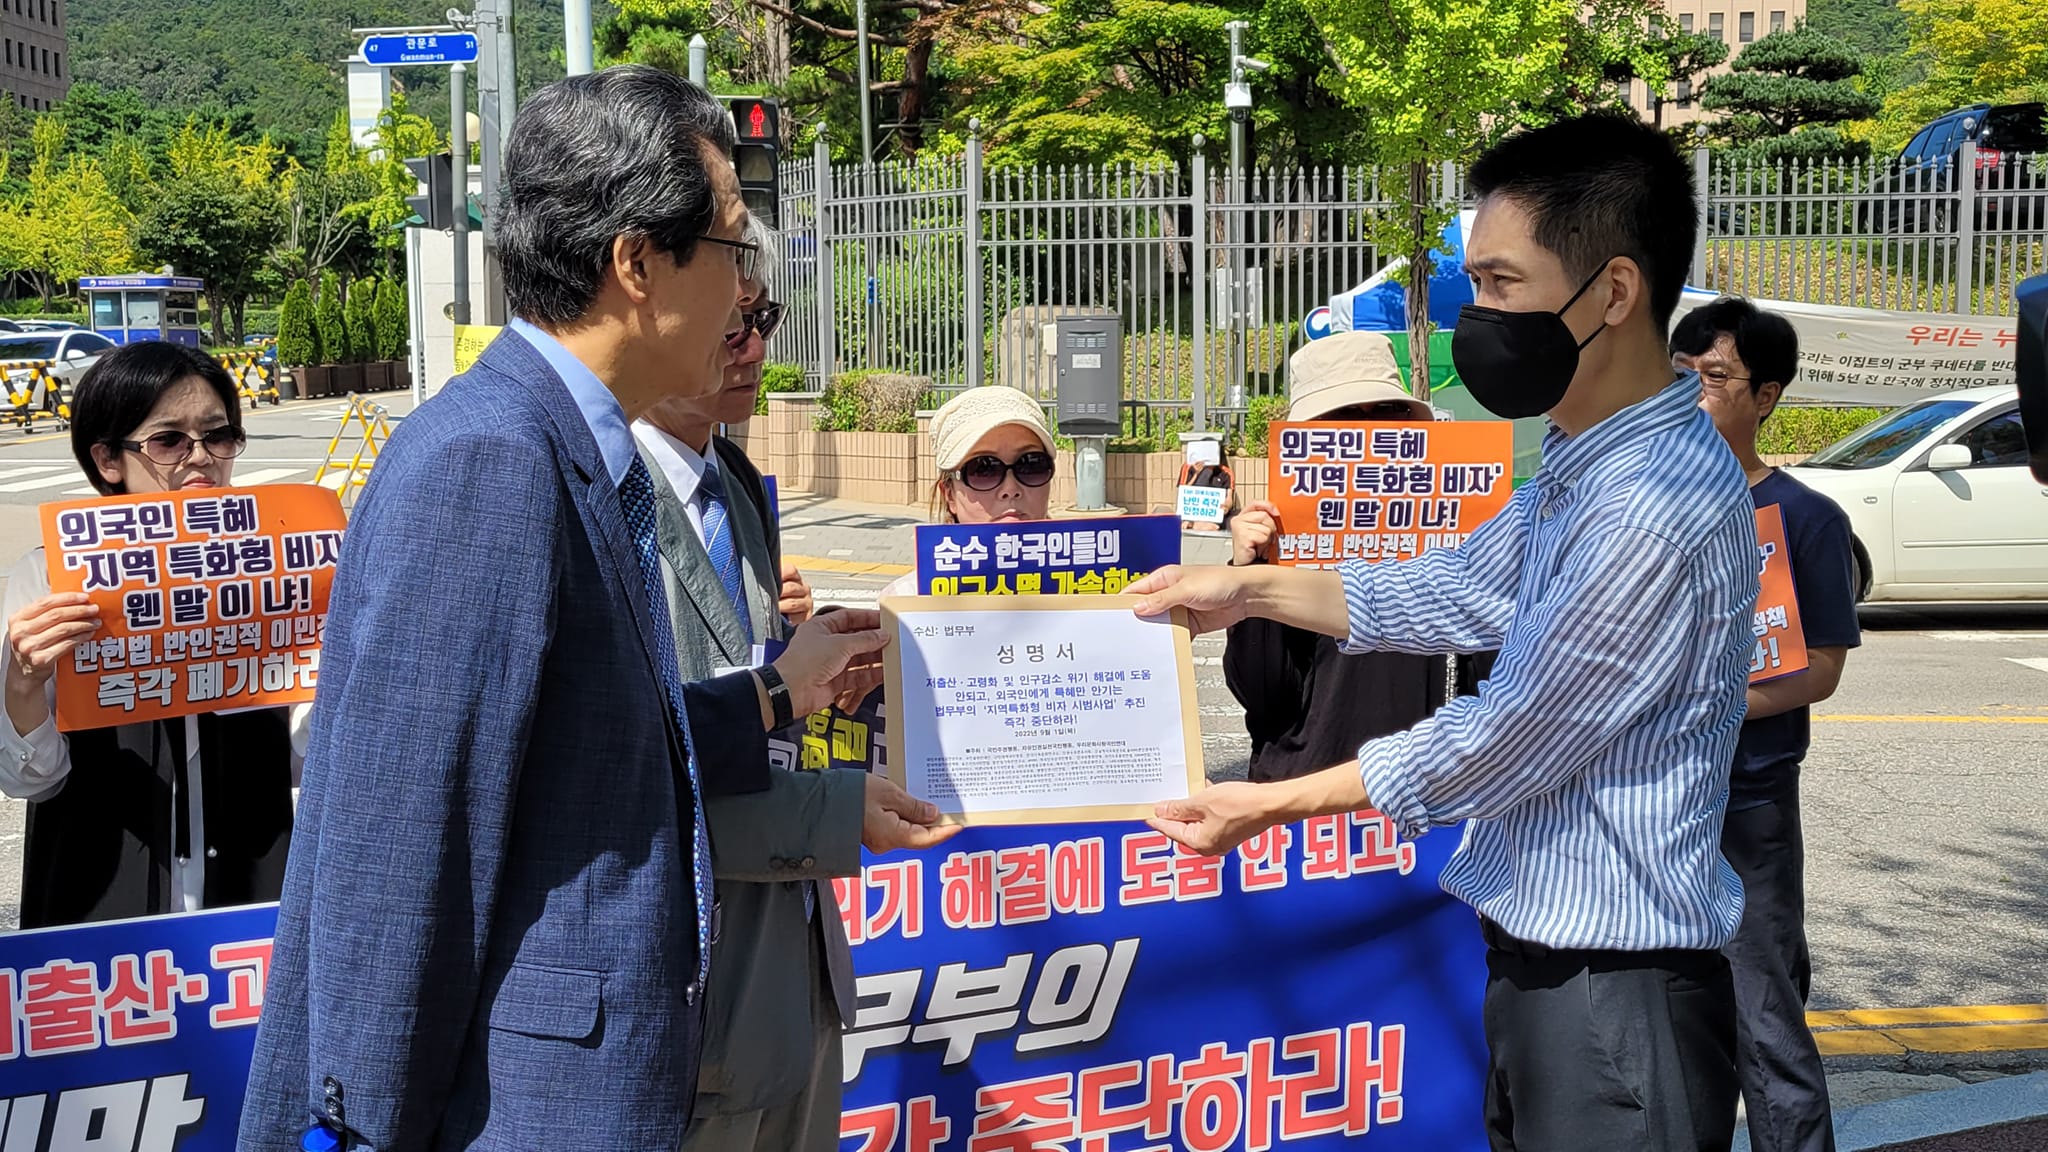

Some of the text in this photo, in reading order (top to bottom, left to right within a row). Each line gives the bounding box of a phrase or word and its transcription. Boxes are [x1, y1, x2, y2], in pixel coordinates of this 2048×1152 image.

[369, 44, 378, 52] 47
[406, 37, 437, 49] 관문로
[1906, 325, 1984, 347] 우리는
[1839, 355, 1894, 370] 이집트의
[1898, 358, 1926, 371] 군부
[1931, 359, 1986, 372] 쿠데타를
[1808, 368, 1833, 383] 위해
[1837, 372, 1860, 385] 5년
[1865, 374, 1879, 385] 전
[1884, 375, 1926, 388] 한국에
[1282, 430, 1425, 459] 외국인 특혜
[1283, 464, 1502, 494] '지역 특화형 비자'
[58, 496, 257, 548] 외국인 특혜
[1319, 500, 1459, 528] 웬 말 이 냐!
[67, 550, 157, 589] '지역
[169, 537, 273, 578] 특화형
[934, 530, 1120, 571] 순수 한국인들의
[126, 577, 310, 629] 웬 말 이 냐!
[914, 625, 975, 637] 수신: 법무부
[98, 667, 177, 711] 즉각
[1004, 676, 1014, 687] 및
[1020, 674, 1062, 686] 인구감소
[1068, 672, 1088, 683] 위기
[1094, 670, 1125, 682] 해결에
[1130, 669, 1152, 680] 도움
[956, 685, 1123, 702] 안되고, 외국인에게 특혜만 안기는
[935, 705, 976, 717] 법무부의
[1046, 701, 1066, 712] 비자
[1124, 697, 1145, 709] 추진
[1004, 714, 1077, 728] 즉각 중단하라!
[941, 837, 1104, 929] 해결에
[1121, 832, 1224, 905] 도움
[1239, 823, 1291, 892] 안
[968, 1022, 1405, 1152] 중단하라!
